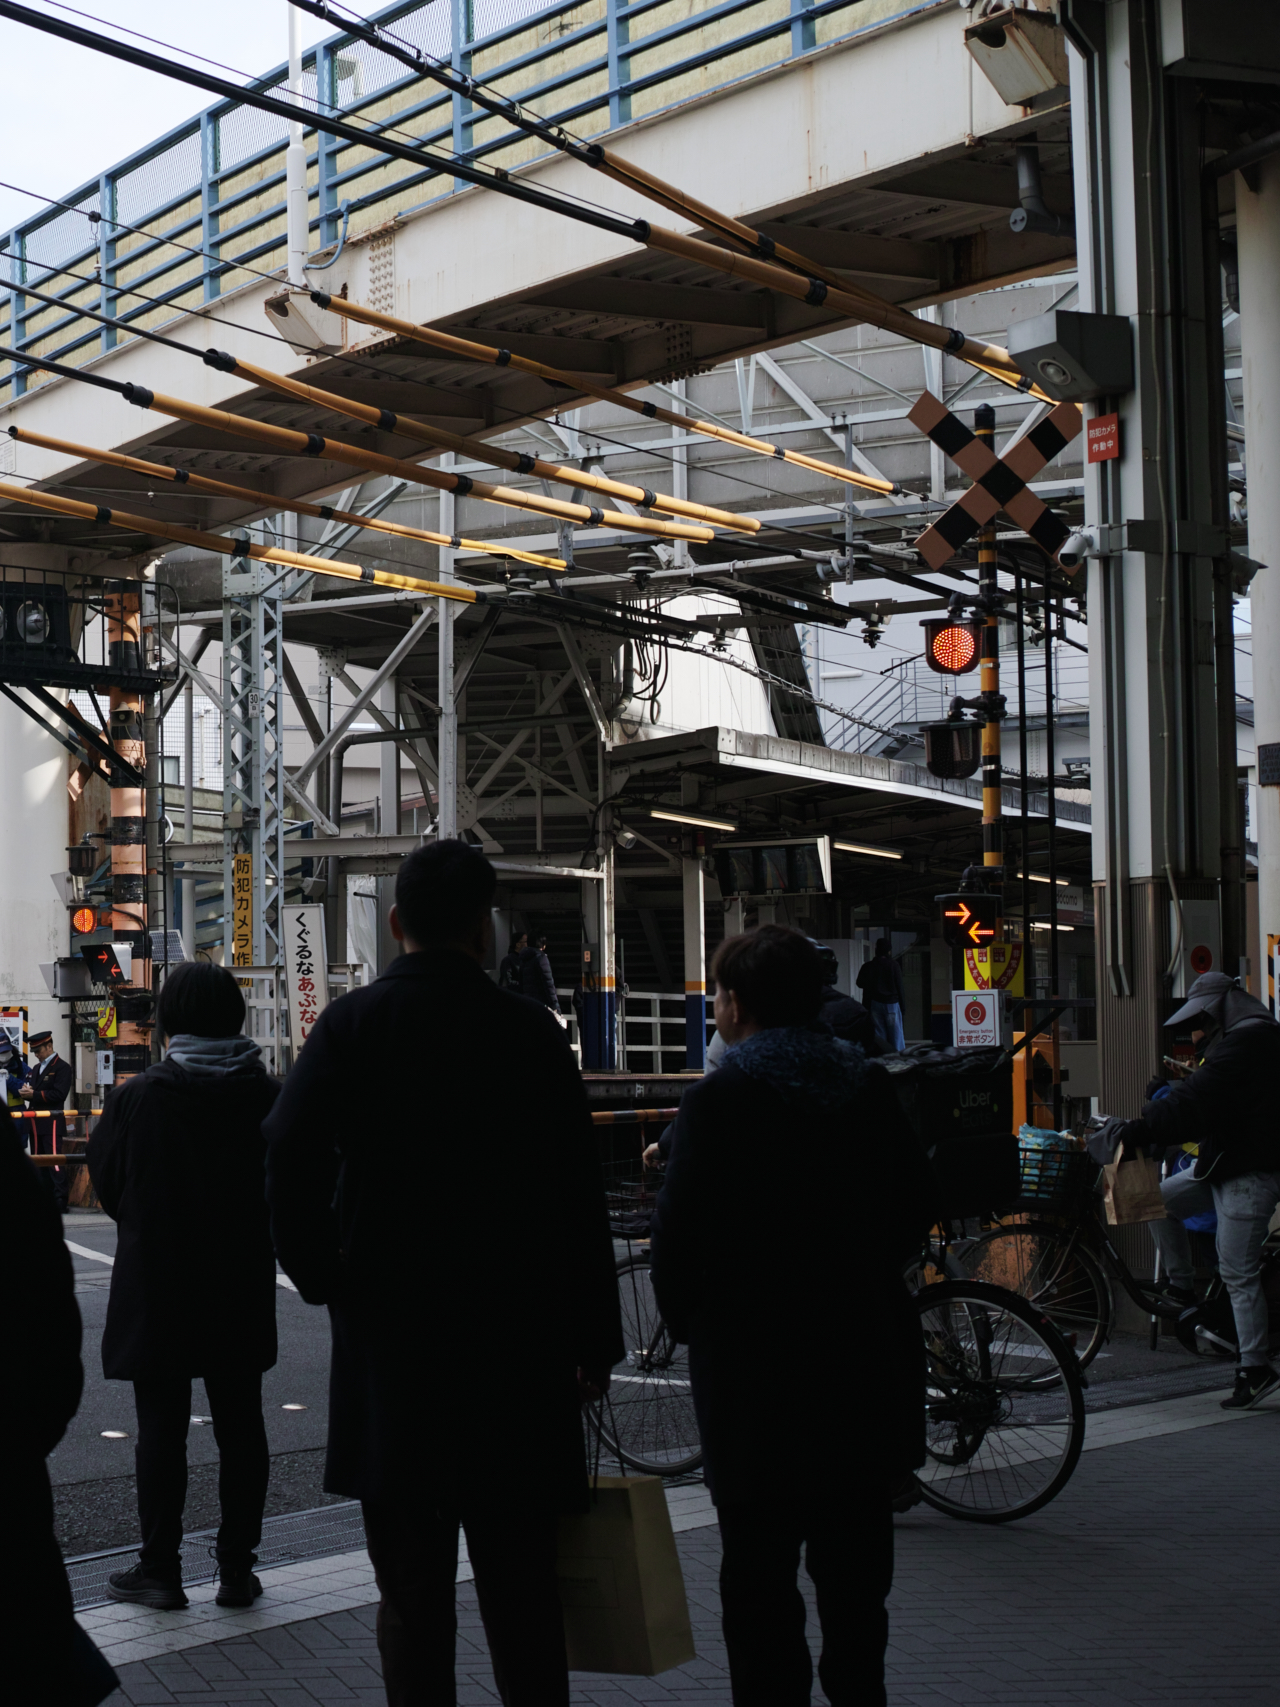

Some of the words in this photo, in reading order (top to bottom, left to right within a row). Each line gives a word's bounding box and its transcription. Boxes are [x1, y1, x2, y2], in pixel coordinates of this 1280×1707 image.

[1089, 423, 1116, 439] 防犯カメラ
[1092, 440, 1114, 453] 作動中
[250, 694, 258, 704] 30
[959, 1035, 995, 1044] 非常ボタン
[959, 1089, 991, 1108] Uber
